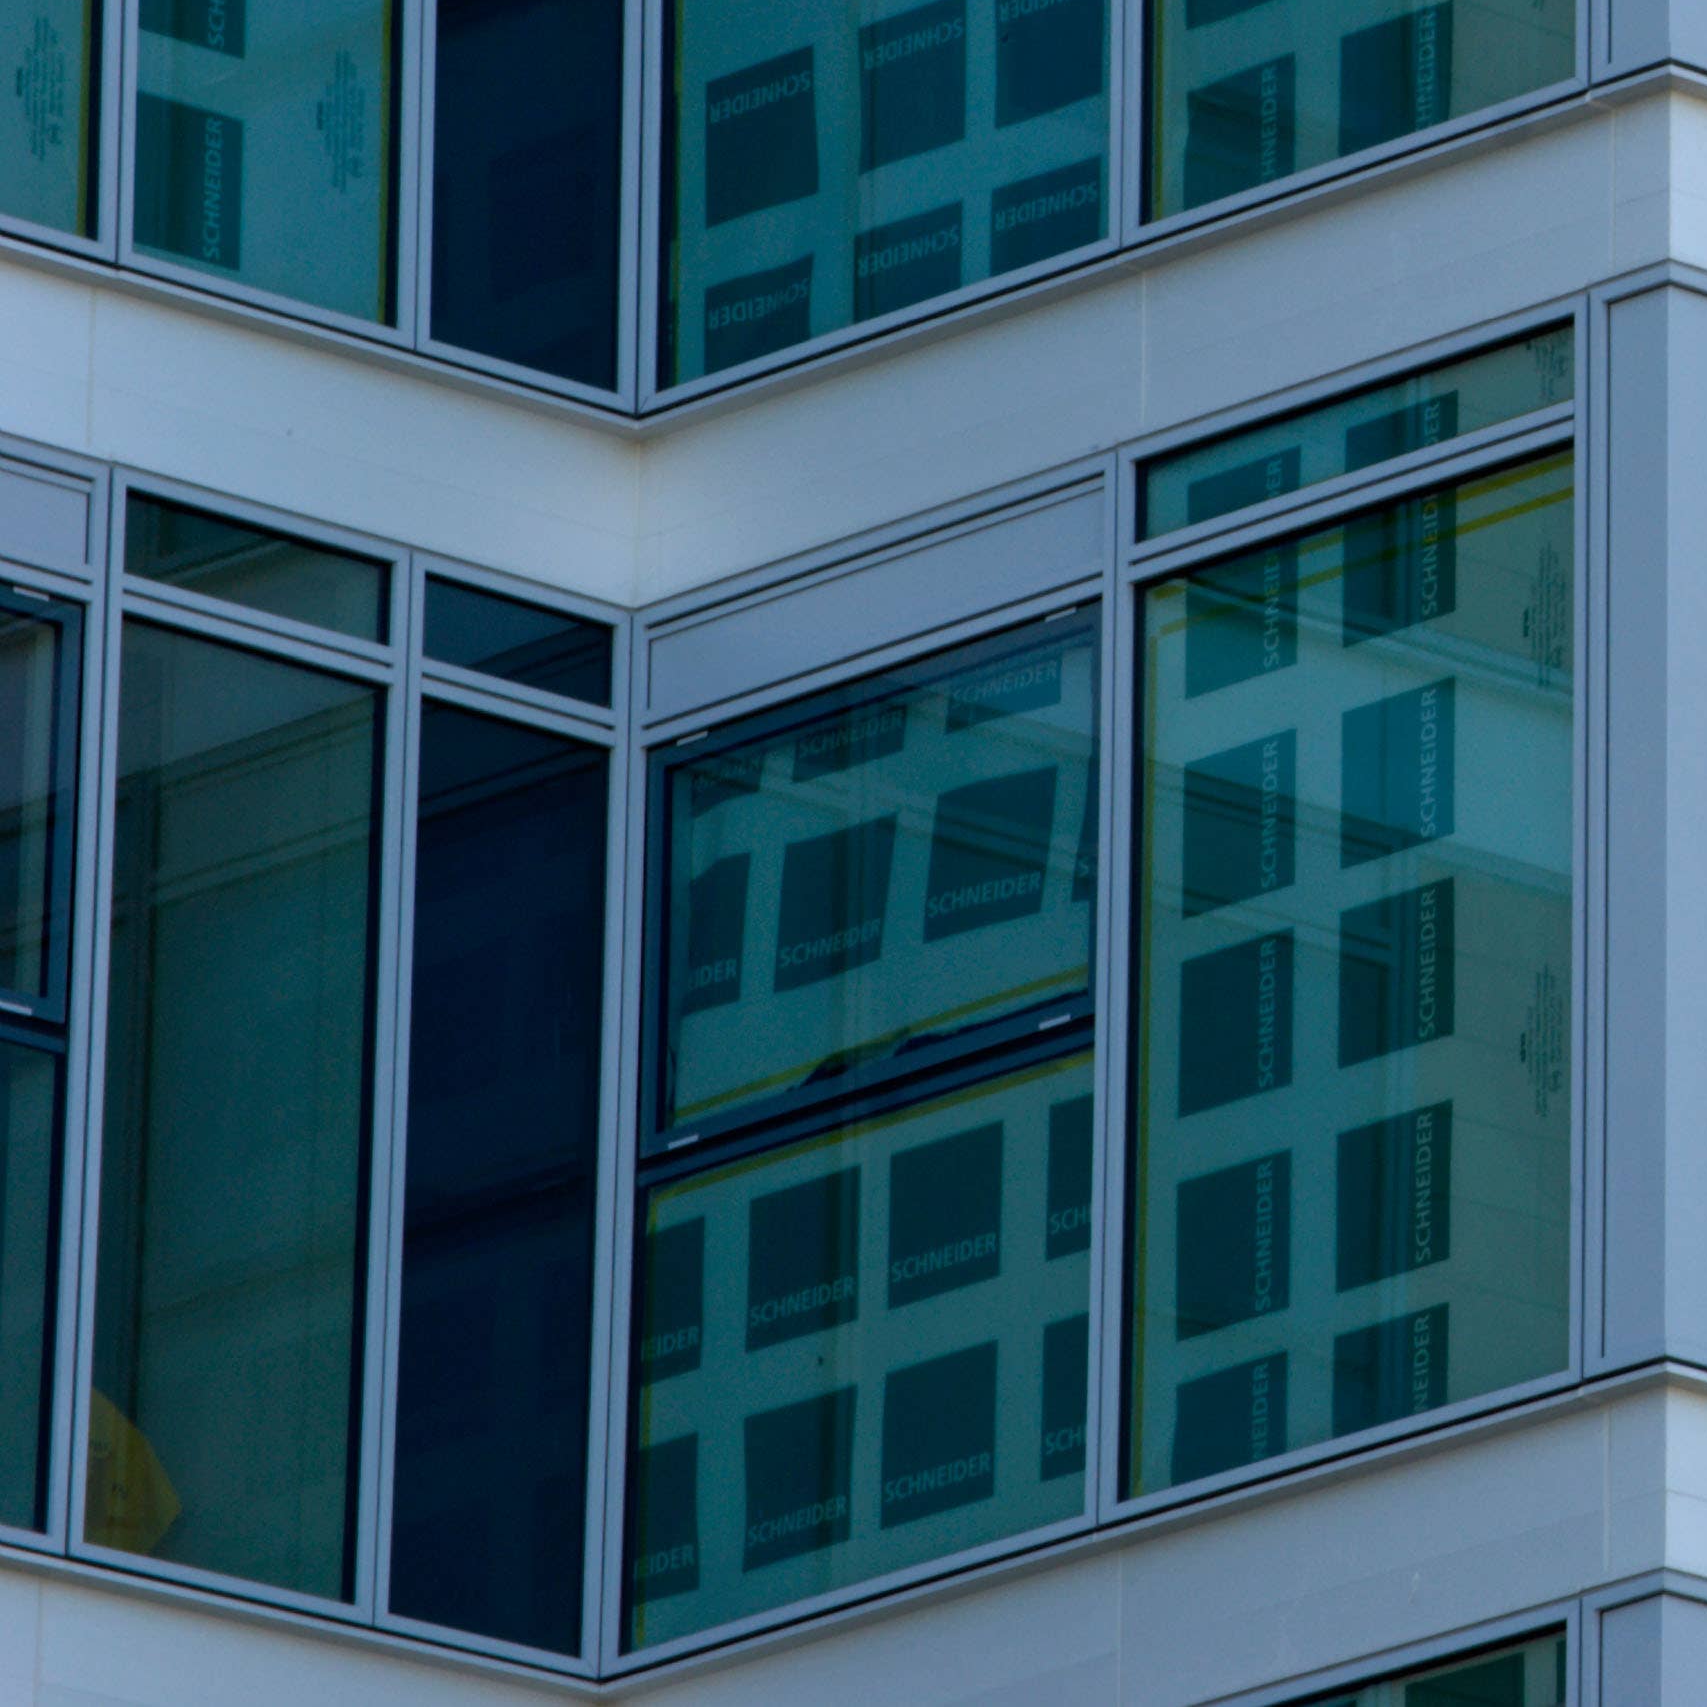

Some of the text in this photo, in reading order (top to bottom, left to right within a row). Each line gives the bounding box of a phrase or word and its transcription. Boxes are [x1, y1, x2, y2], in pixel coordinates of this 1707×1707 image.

[862, 17, 966, 72] SCHNEIDER
[708, 71, 813, 126] SCHNEIDER
[201, 116, 225, 263] SCHNEIDER
[995, 180, 1099, 233] SCHNEIDER
[856, 225, 960, 279] SCHNEIDER
[707, 276, 812, 333] SCHNEIDER
[1419, 688, 1438, 839] SCHNEIDER
[1260, 738, 1280, 890] SCHNEIDER
[926, 870, 1042, 921] SCHNEIDER
[778, 917, 882, 970] SCHNEIDER
[1417, 889, 1437, 1040] SCHNEIDER
[1256, 938, 1278, 1089] SCHNEIDER
[1413, 1110, 1435, 1265] SCHNEIDER
[890, 1231, 998, 1284] SCHNEIDER
[1254, 1159, 1275, 1313] SCHNEIDER
[747, 1275, 856, 1328] SCHNEIDER
[883, 1451, 992, 1503] SCHNEIDER
[746, 1495, 849, 1548] SCHNEIDER
